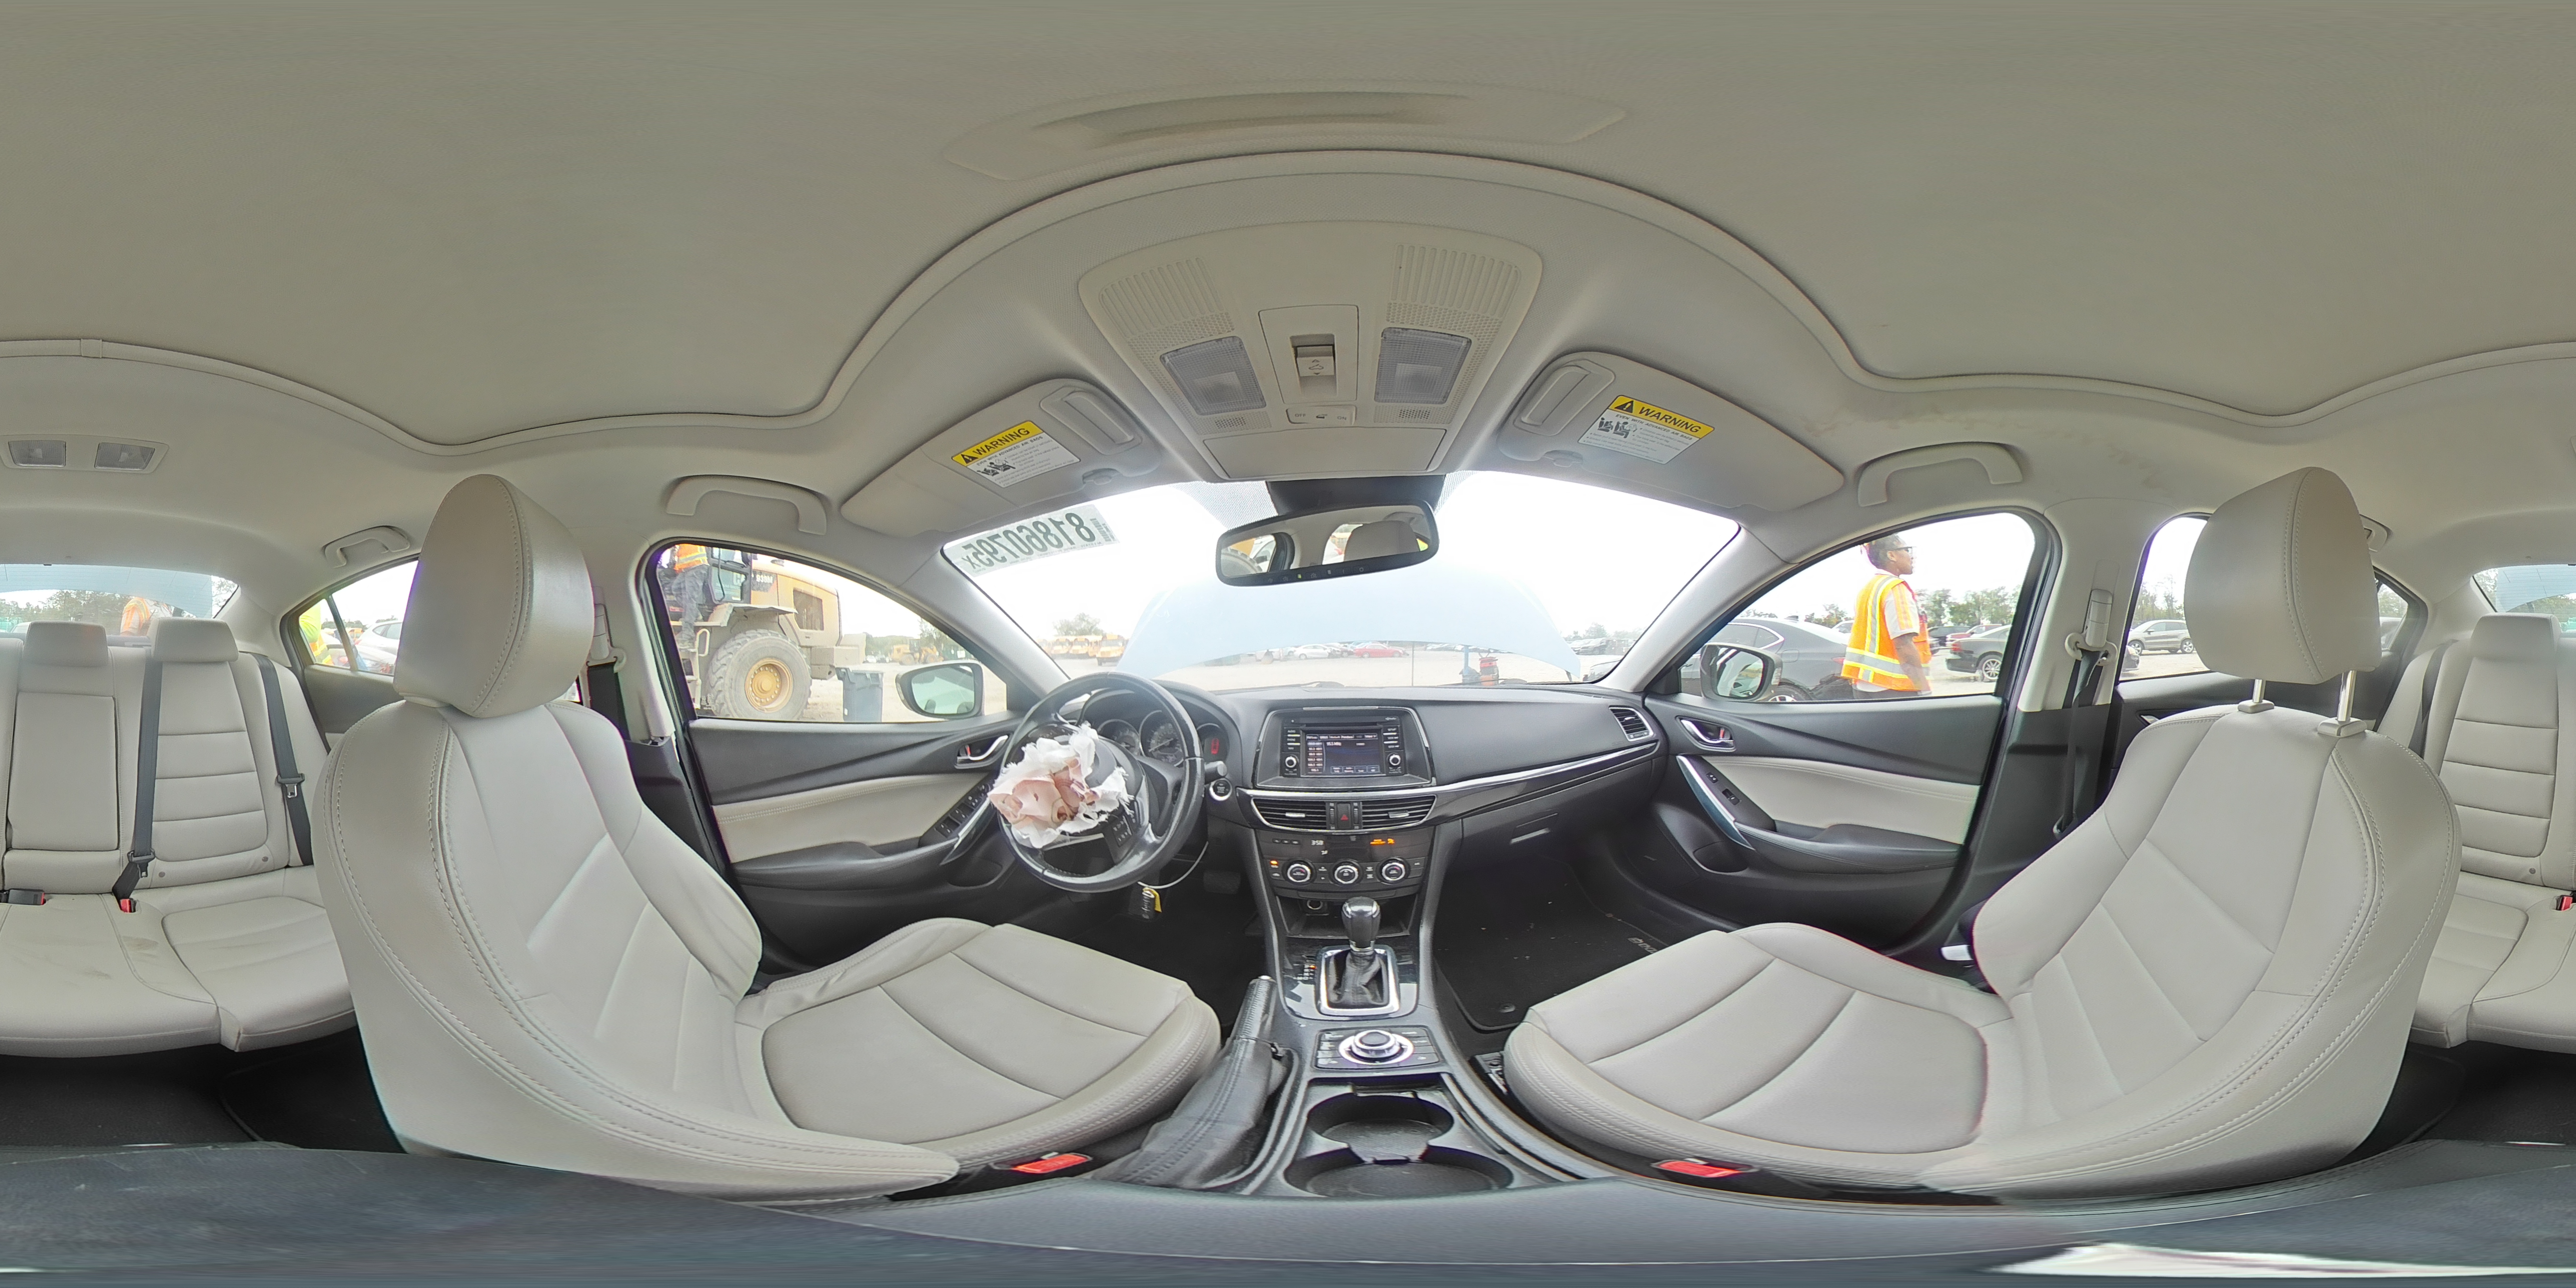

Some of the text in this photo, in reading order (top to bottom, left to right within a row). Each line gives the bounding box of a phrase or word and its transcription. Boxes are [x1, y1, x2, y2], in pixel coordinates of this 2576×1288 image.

[1639, 406, 1702, 433] WARNING
[1645, 423, 1670, 433] ADVANCED
[973, 428, 1030, 456] WARNING
[999, 445, 1020, 457] ADVANCED
